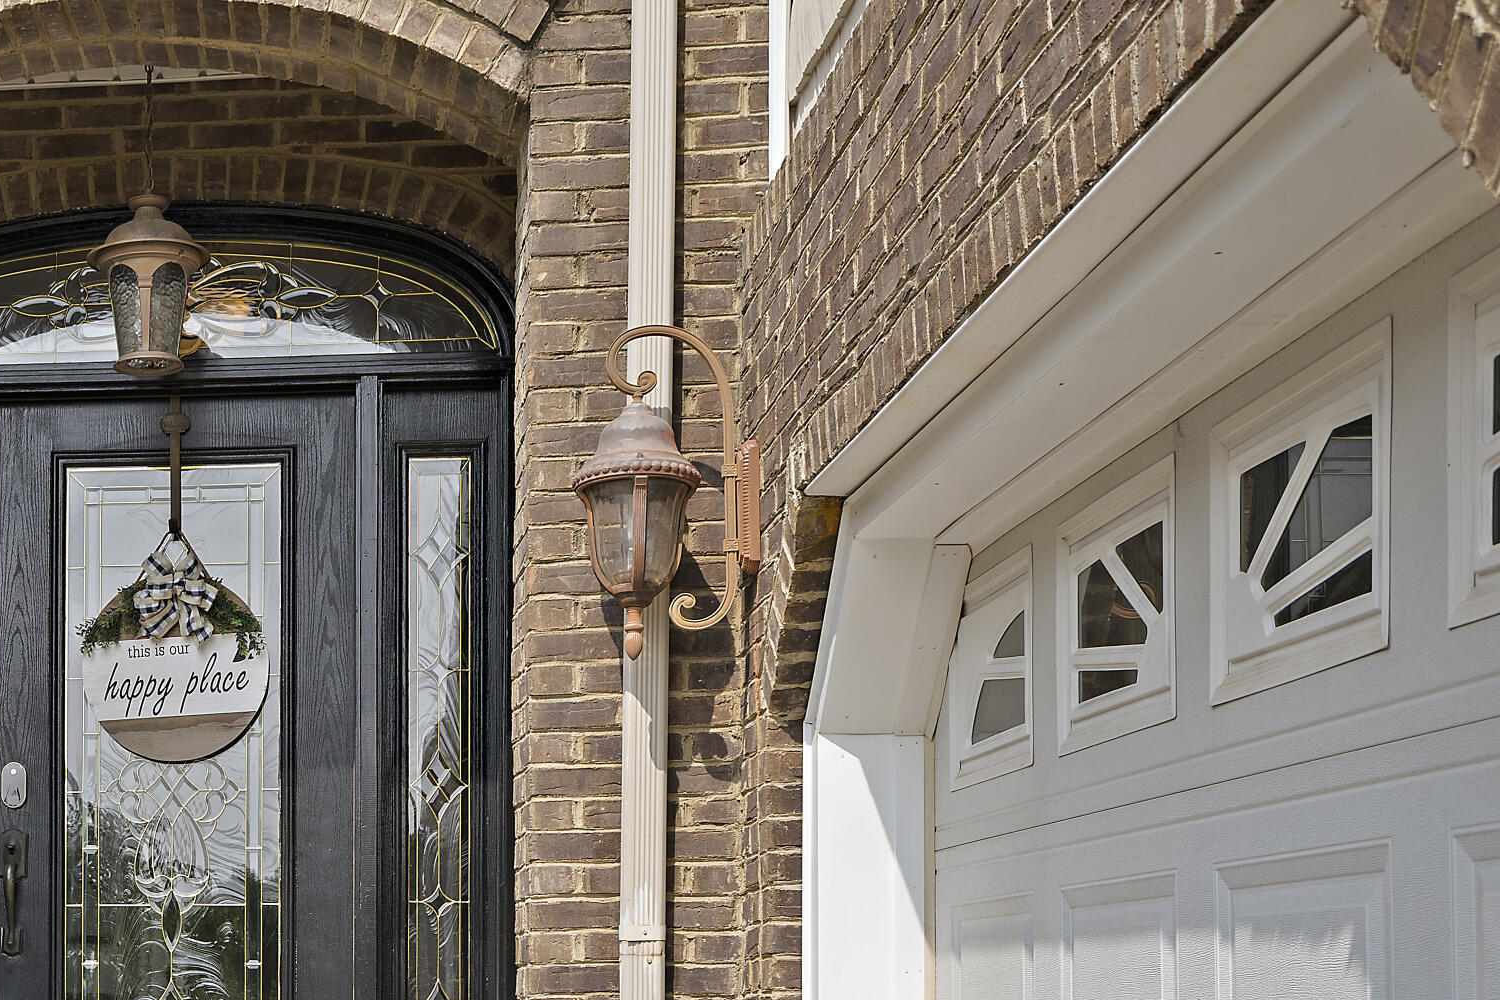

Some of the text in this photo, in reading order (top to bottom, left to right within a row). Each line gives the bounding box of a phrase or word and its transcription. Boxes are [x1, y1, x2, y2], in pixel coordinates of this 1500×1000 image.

[128, 643, 190, 658] this is our
[104, 652, 249, 718] happy place
